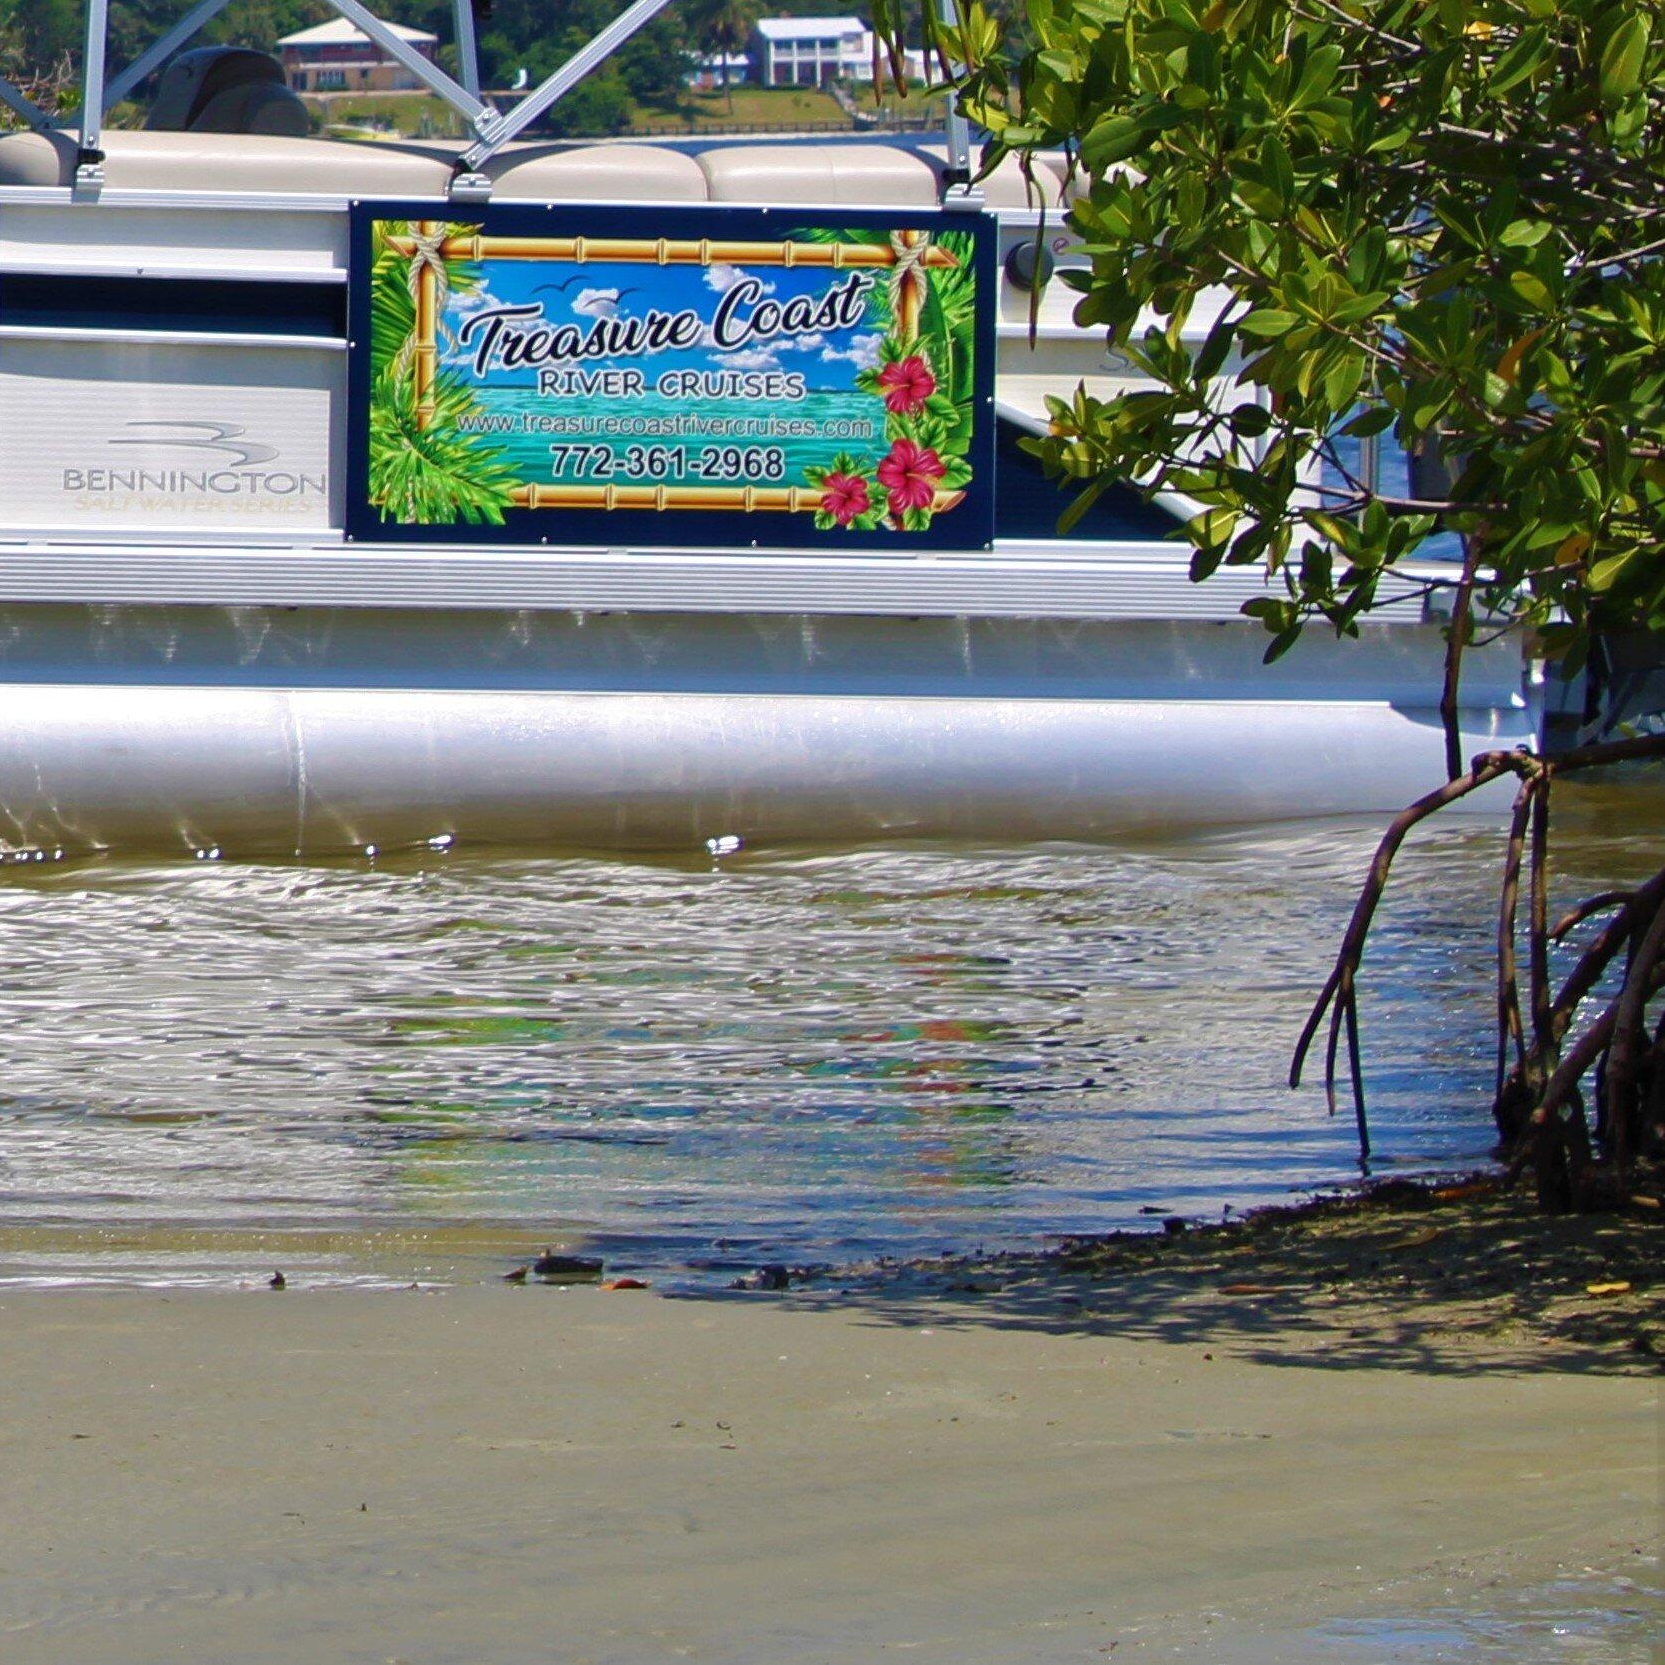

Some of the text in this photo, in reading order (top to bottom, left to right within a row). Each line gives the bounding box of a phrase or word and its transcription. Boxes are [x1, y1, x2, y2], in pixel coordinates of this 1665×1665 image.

[459, 272, 874, 376] Treasure Coast
[538, 368, 806, 400] RIVER CRUISES
[457, 411, 873, 439] www.treasurecoastrivercruises.com
[550, 444, 785, 480] 772-361-2968
[63, 468, 326, 495] BENNINGTON
